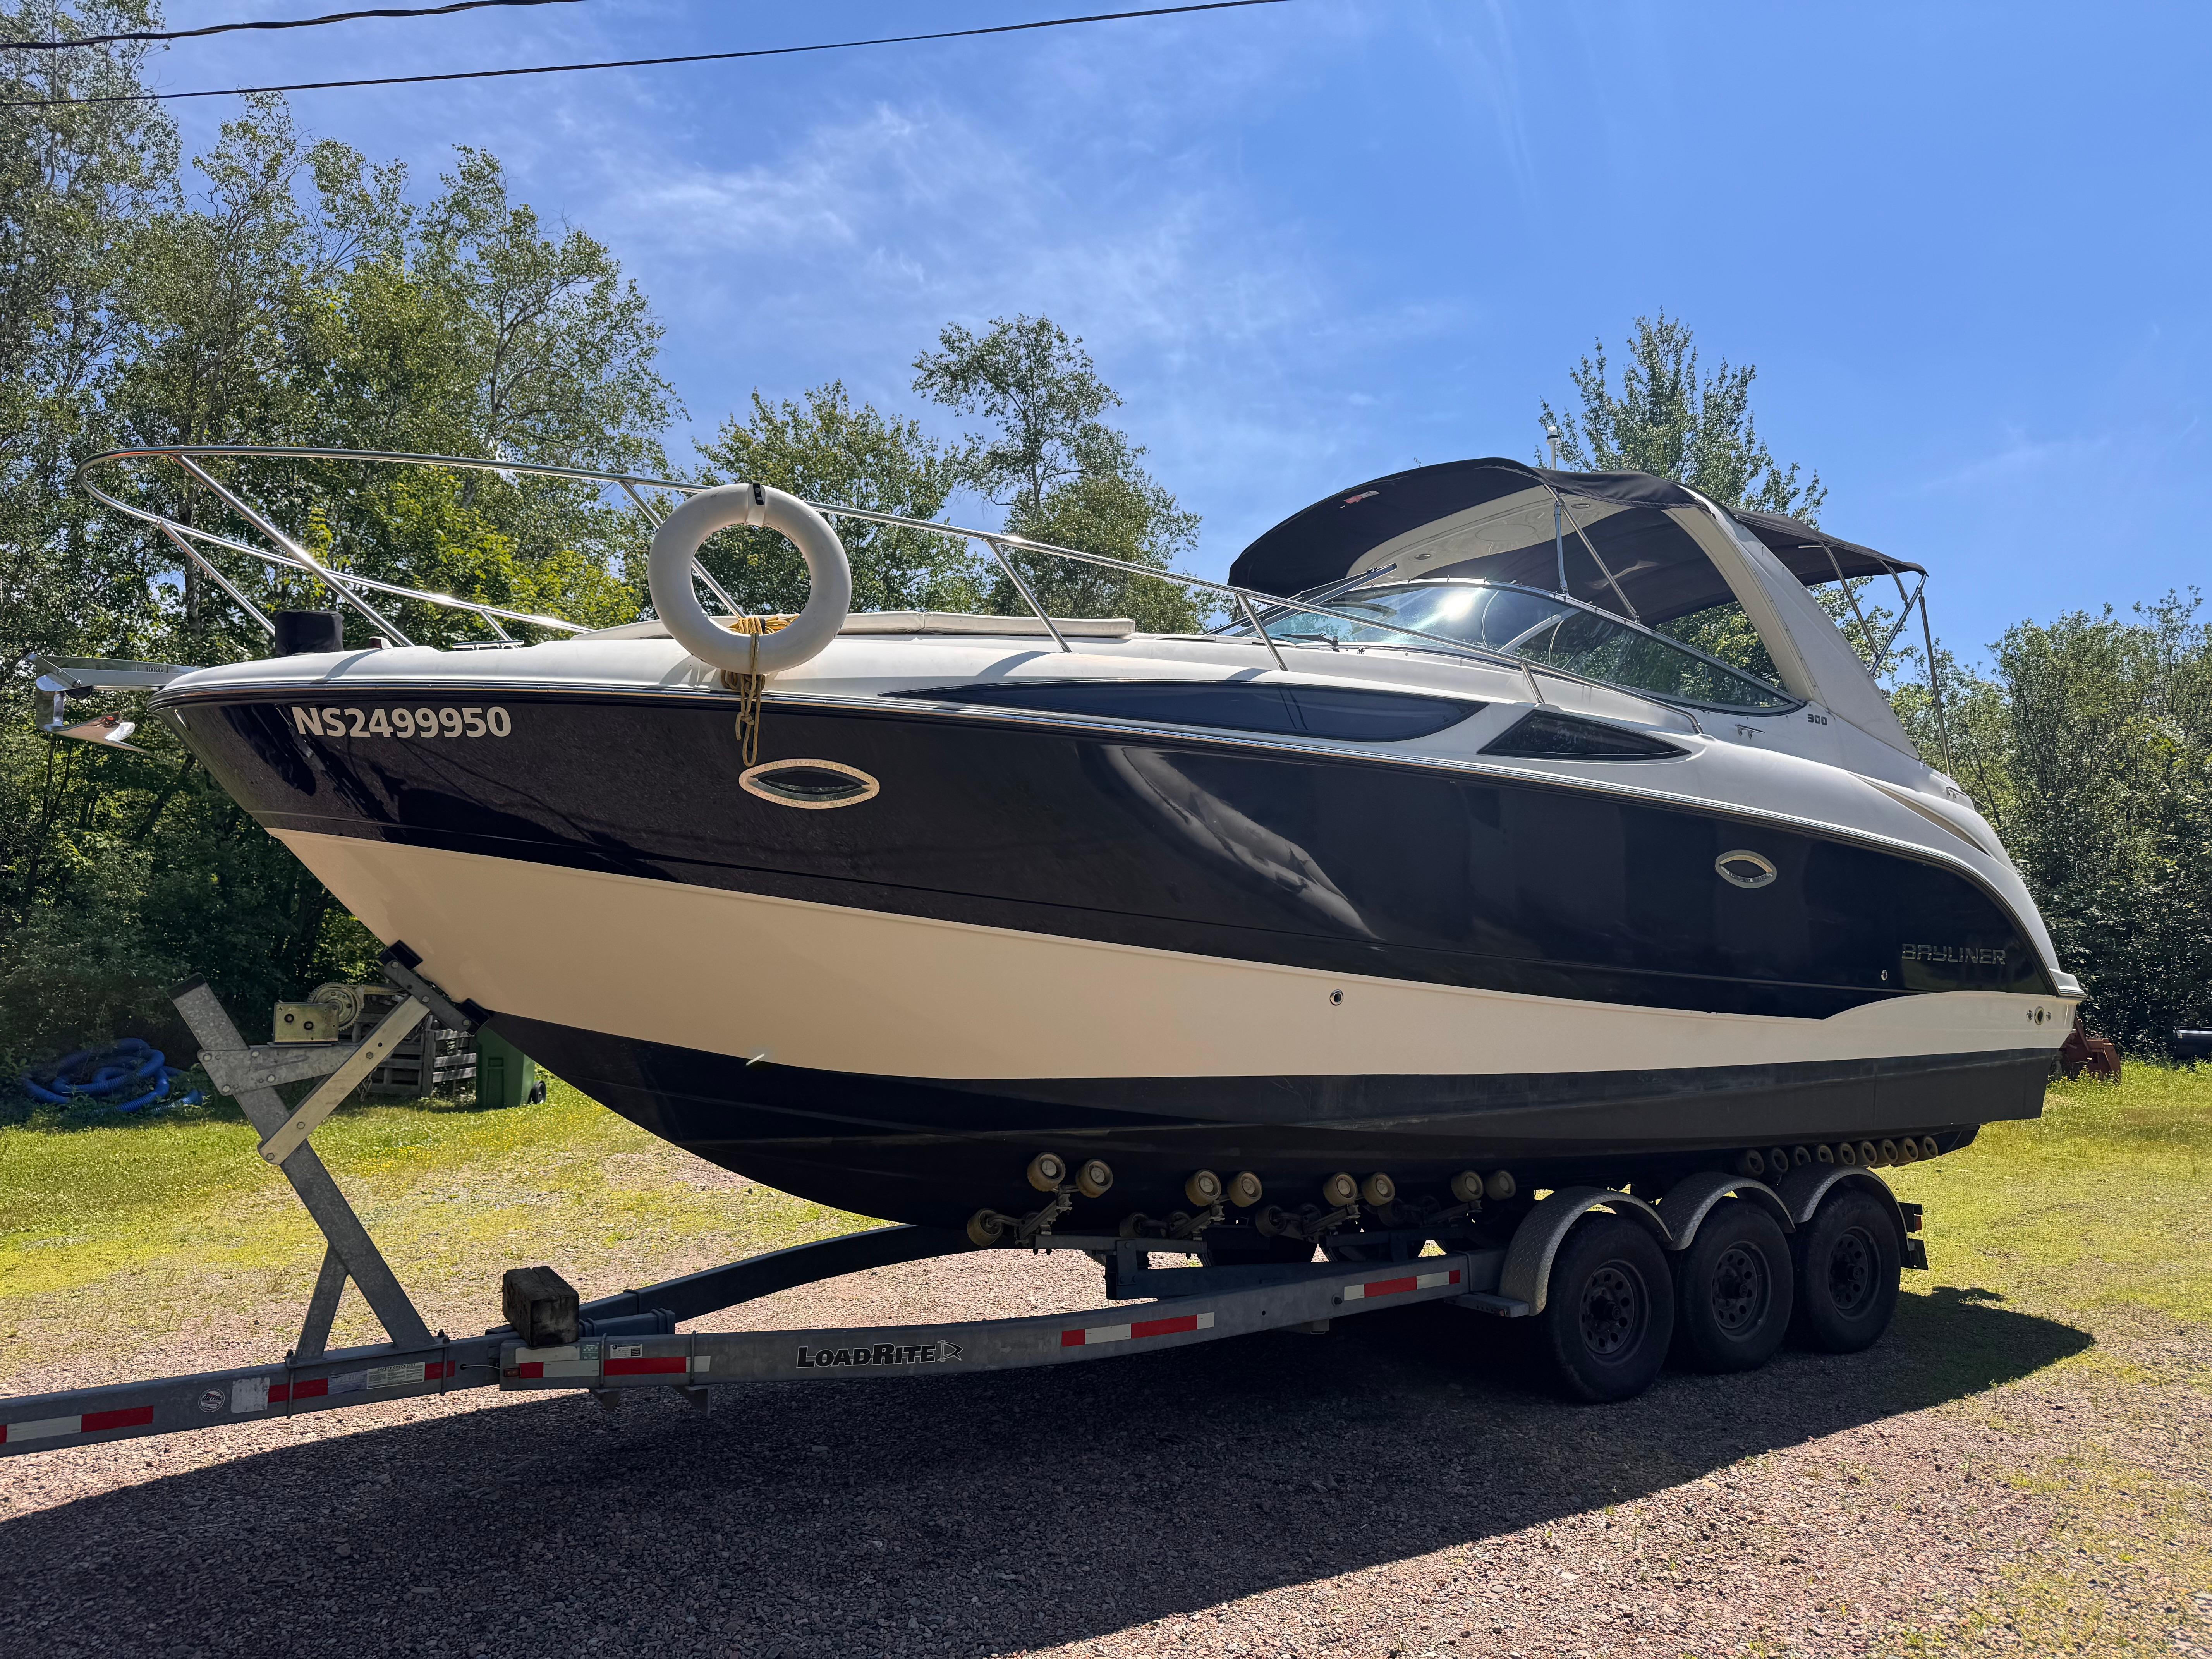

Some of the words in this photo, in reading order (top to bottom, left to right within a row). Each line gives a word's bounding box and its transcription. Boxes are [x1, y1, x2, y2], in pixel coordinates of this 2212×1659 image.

[291, 706, 512, 738] NS2499950
[1807, 713, 1827, 726] 300
[1901, 943, 2006, 965] BAYLINER
